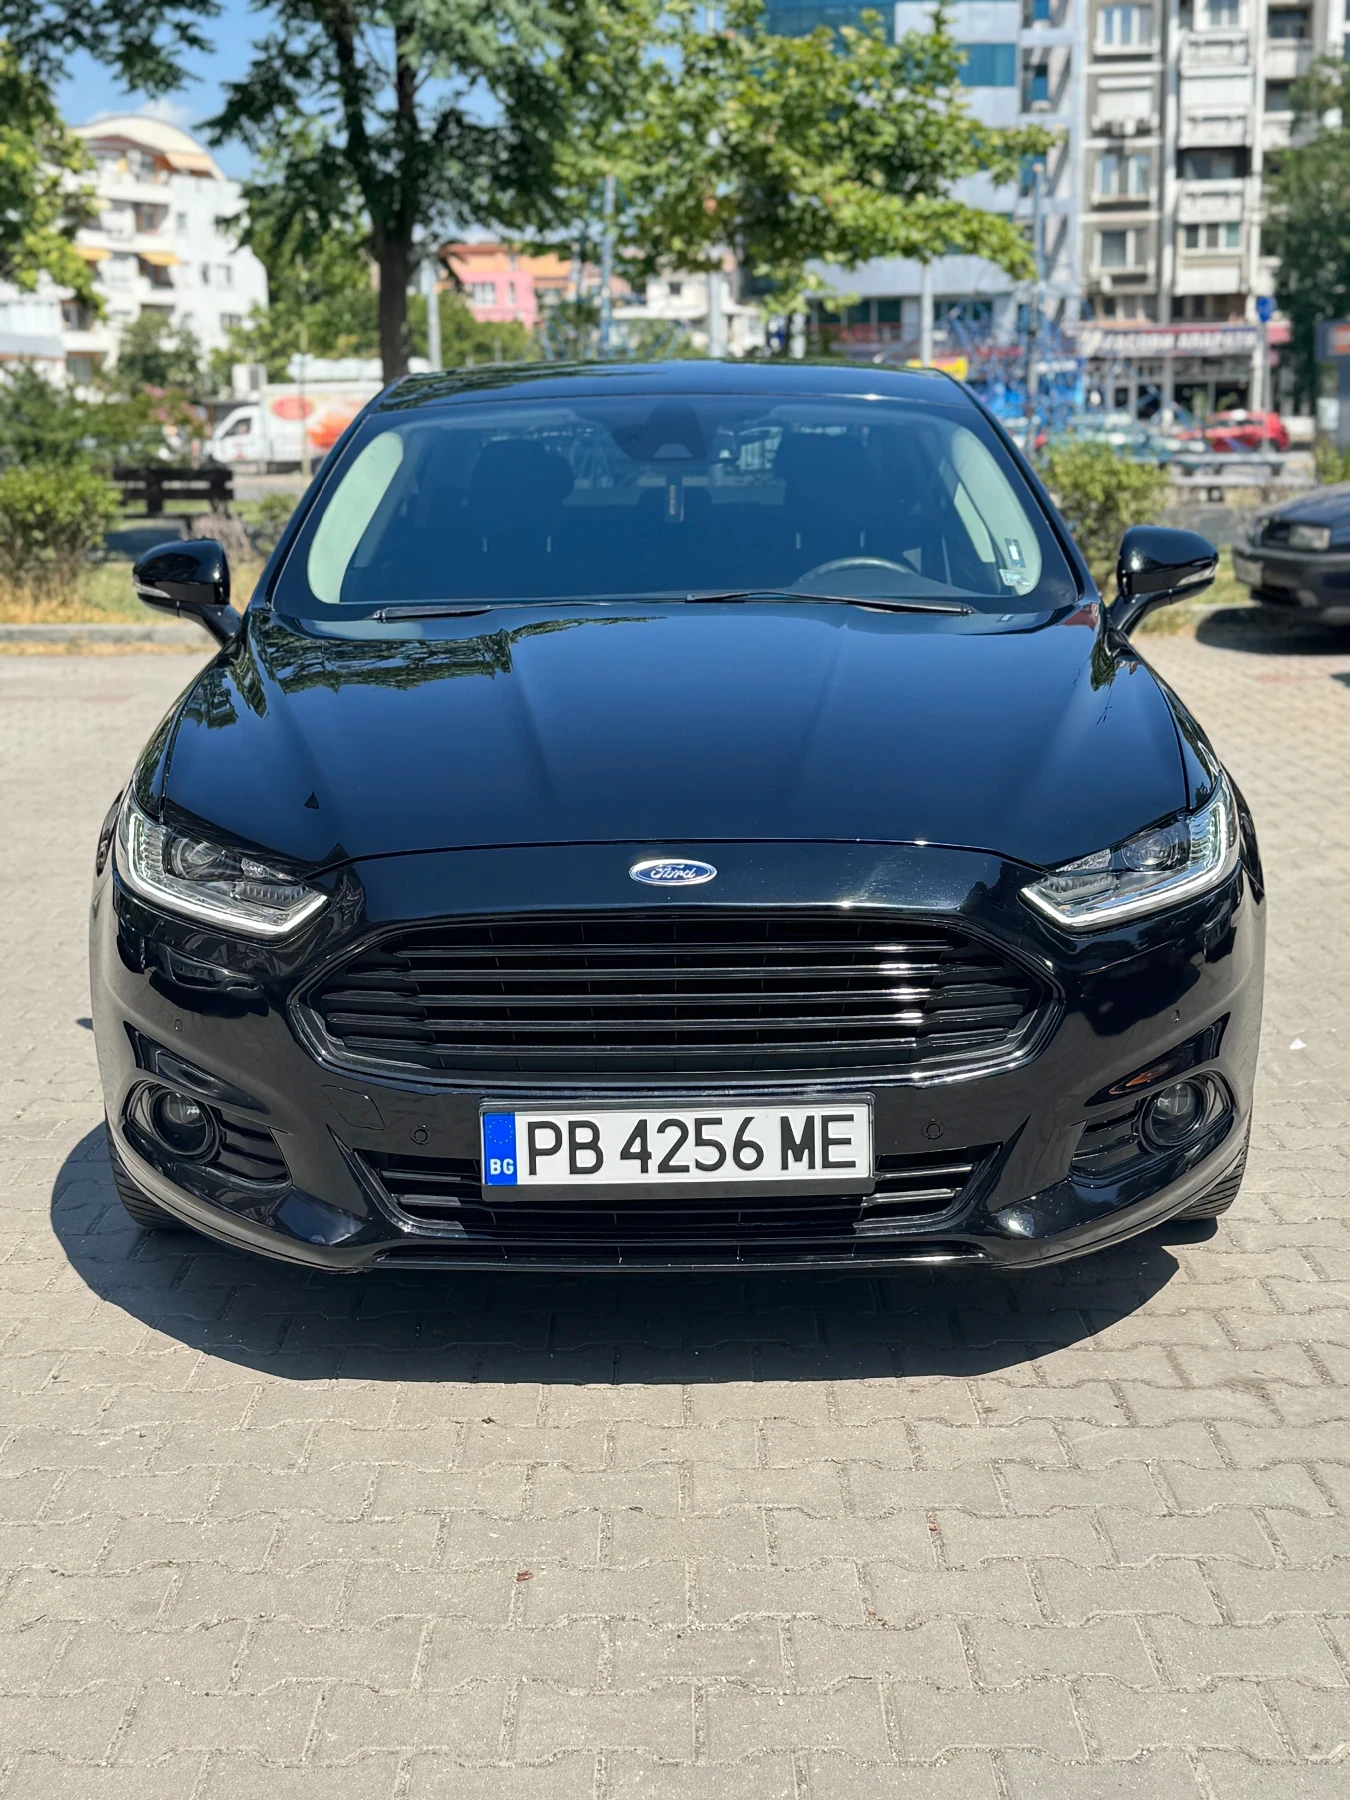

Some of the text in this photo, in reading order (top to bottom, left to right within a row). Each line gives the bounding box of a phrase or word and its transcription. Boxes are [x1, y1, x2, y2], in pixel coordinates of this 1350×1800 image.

[650, 864, 697, 879] Ford
[527, 1114, 857, 1176] PB 4256 ME
[490, 1158, 514, 1175] BG
